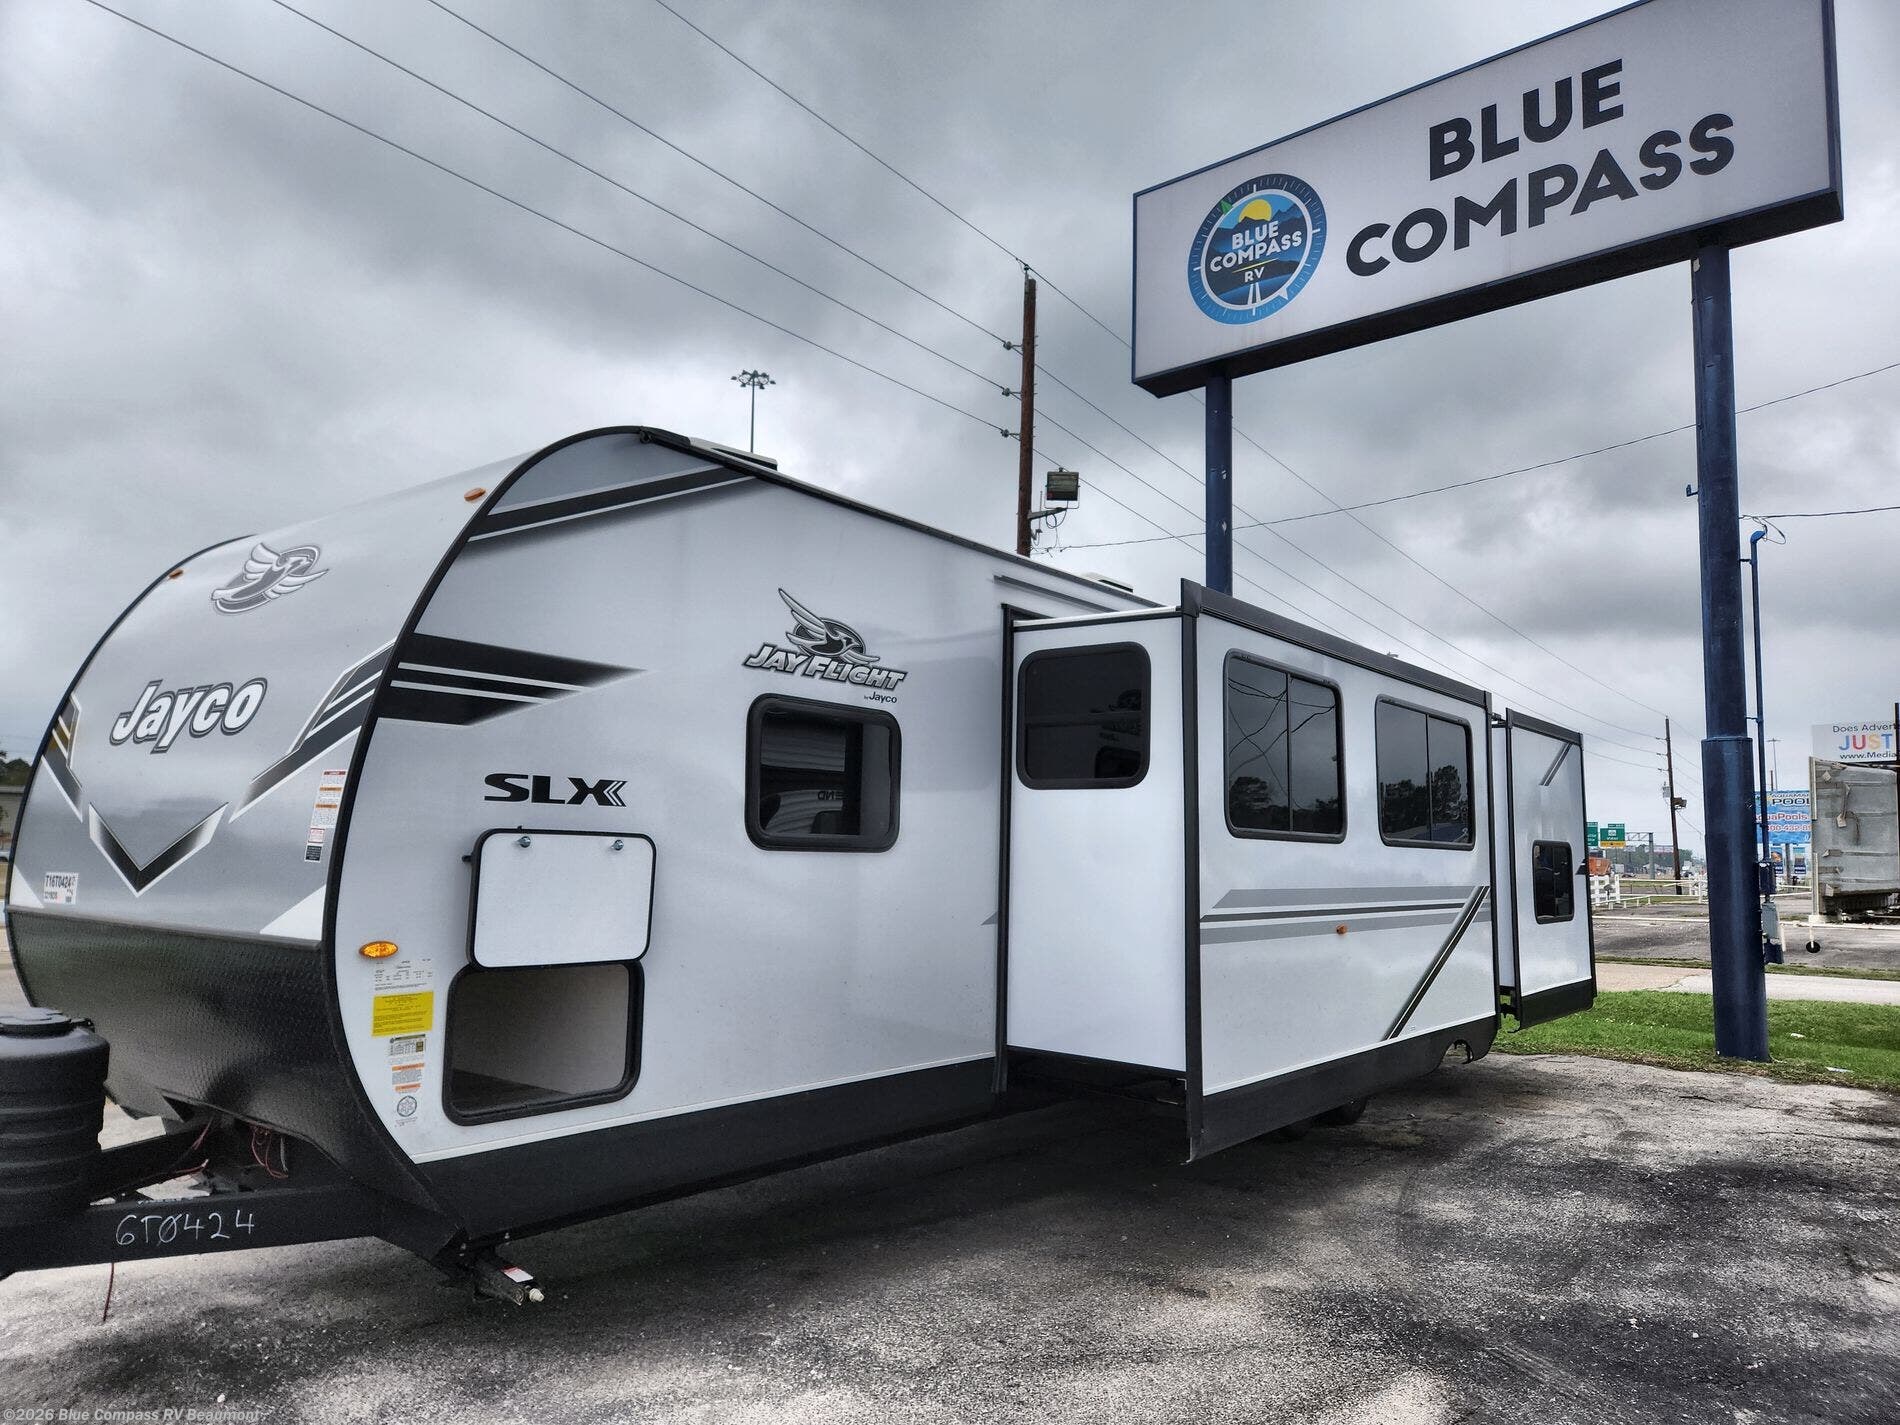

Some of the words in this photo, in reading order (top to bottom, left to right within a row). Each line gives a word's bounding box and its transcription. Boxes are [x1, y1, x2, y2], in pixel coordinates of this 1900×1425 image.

[1428, 58, 1624, 181] BLUE
[1346, 114, 1735, 277] COMPASS
[1209, 231, 1302, 272] COMPASS
[1232, 220, 1279, 249] BLUE
[1244, 266, 1265, 283] RV
[742, 643, 812, 673] JAY
[801, 655, 908, 691] FLIGHT
[869, 691, 897, 703] Jayco
[109, 677, 268, 754] Jayco
[1832, 725, 1859, 733] Does
[1861, 723, 1896, 732] Adver
[1838, 733, 1893, 750] JUST
[484, 772, 627, 807] SLX
